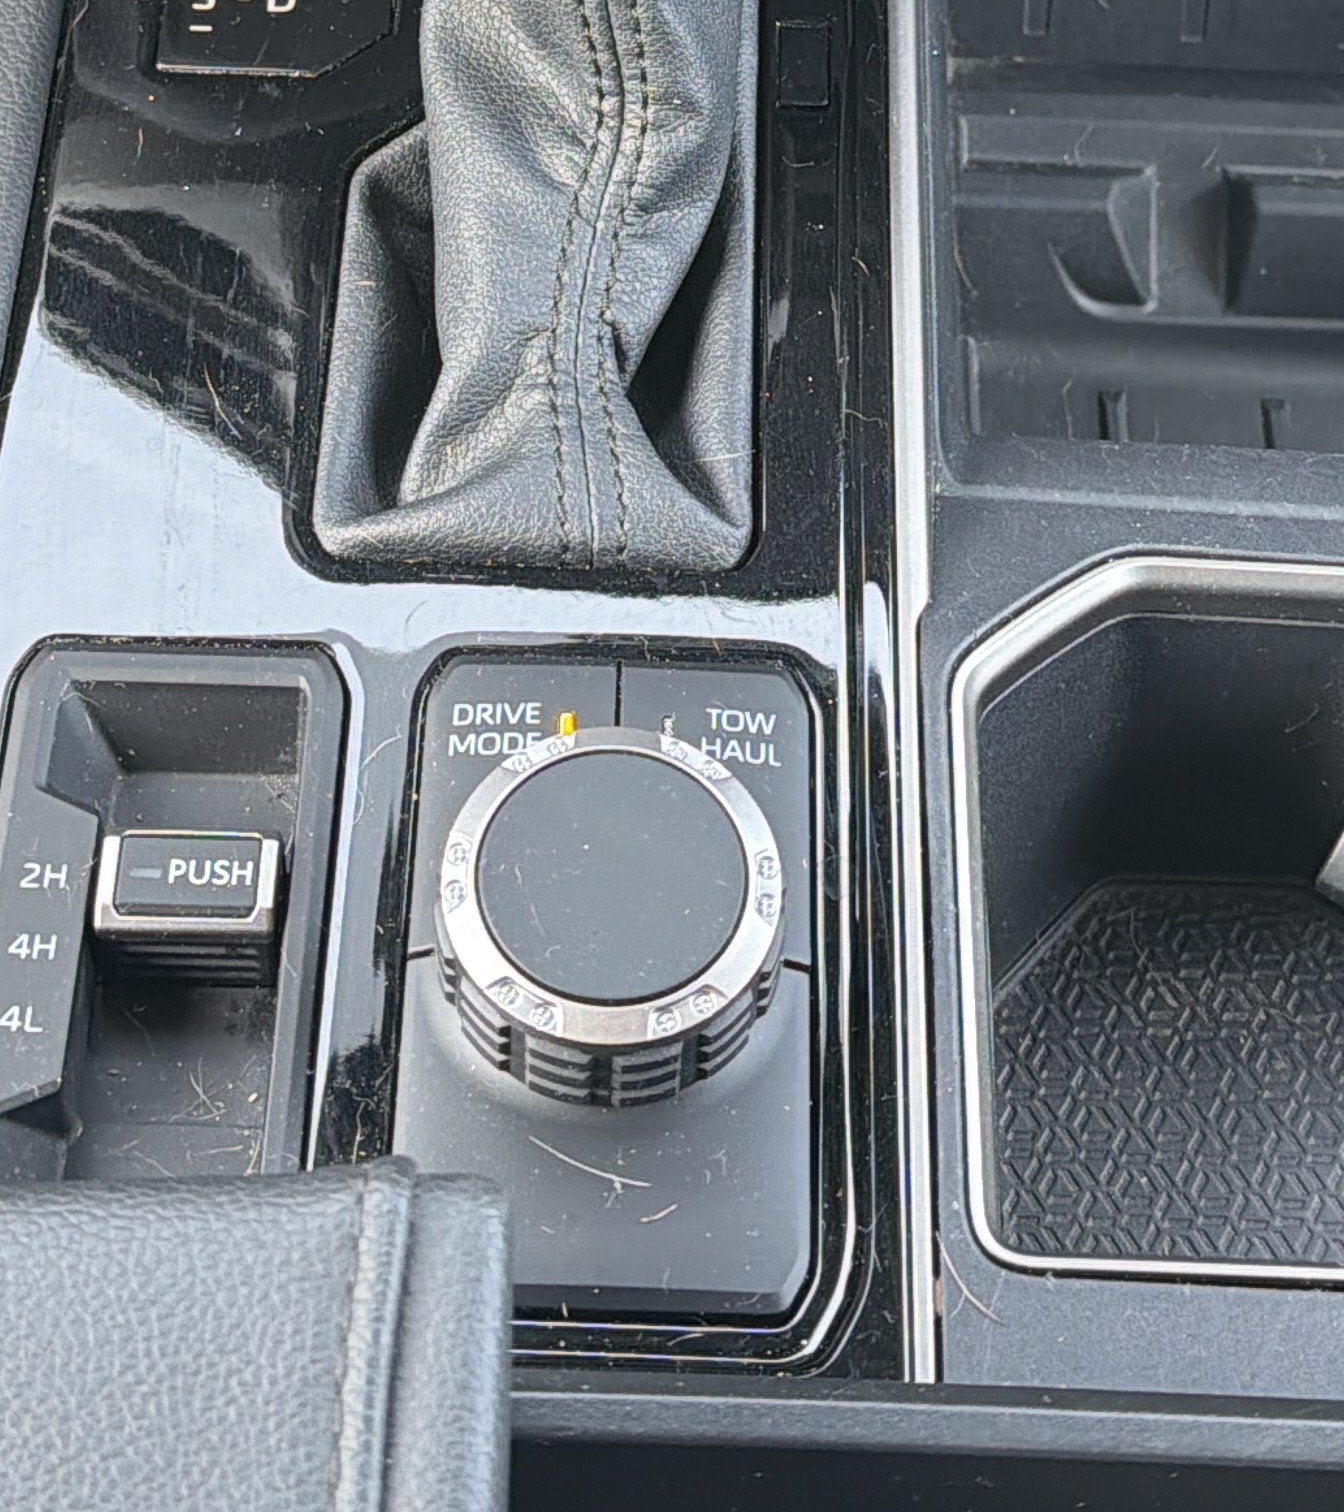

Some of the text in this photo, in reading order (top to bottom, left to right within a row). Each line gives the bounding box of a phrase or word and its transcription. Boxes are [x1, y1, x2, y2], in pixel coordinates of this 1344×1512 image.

[452, 702, 542, 727] DRIVE
[705, 707, 777, 735] TOW
[700, 736, 782, 768] HAUL
[19, 862, 68, 889] 2H
[167, 858, 255, 886] PUSH
[7, 933, 57, 961] 4H
